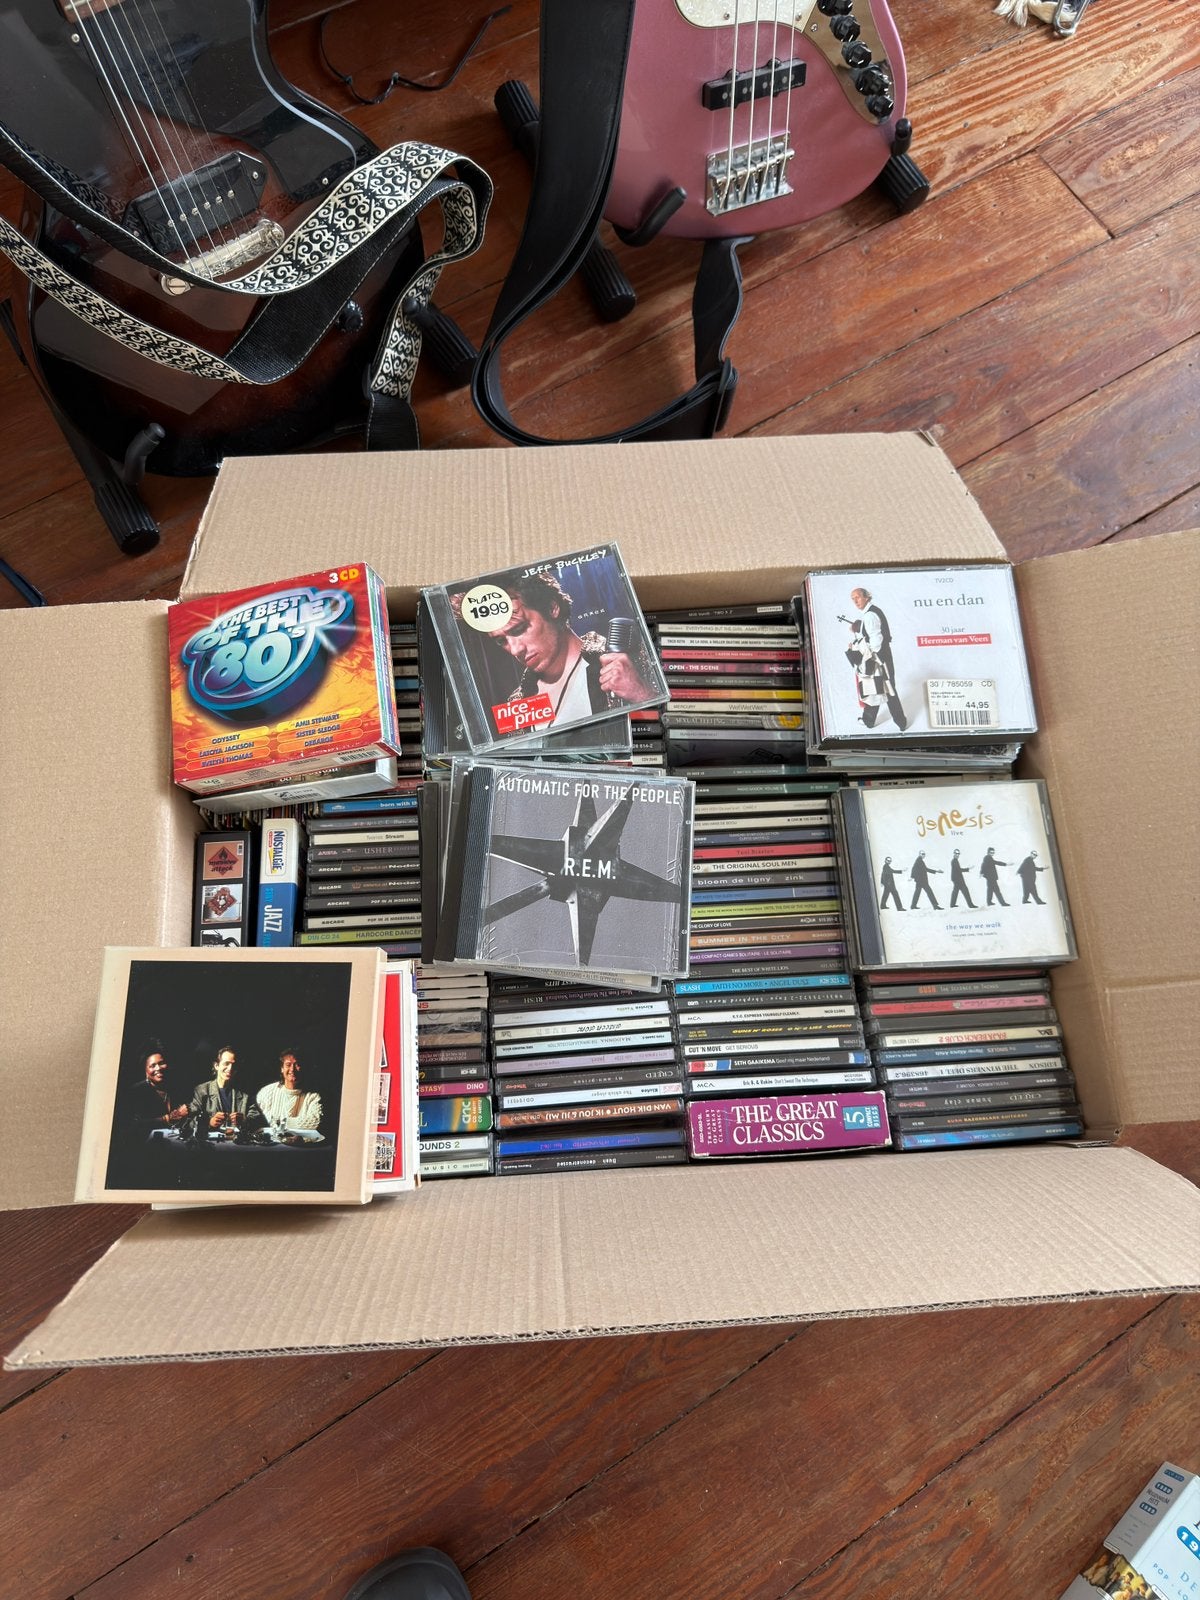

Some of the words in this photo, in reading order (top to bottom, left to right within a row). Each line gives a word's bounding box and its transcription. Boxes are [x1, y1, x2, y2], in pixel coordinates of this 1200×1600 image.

[521, 564, 552, 579] JEFF
[556, 549, 607, 569] BUCKLEY
[329, 573, 339, 583] 3
[339, 568, 359, 581] CD
[467, 592, 502, 604] PLATO
[914, 597, 933, 607] nu
[936, 597, 954, 606] en
[957, 594, 984, 606] dan
[220, 609, 251, 630] THE
[256, 596, 301, 619] BEST
[577, 609, 606, 619] GRACE
[200, 629, 238, 651] OF
[245, 598, 332, 638] THE
[941, 626, 950, 634] 30
[951, 626, 966, 635] jaar
[920, 636, 953, 645] Herman
[969, 635, 988, 643] Veen
[497, 702, 528, 719] nice
[965, 701, 989, 709] 44,95
[311, 713, 340, 725] STEWART
[515, 706, 552, 729] price
[212, 733, 240, 745] ODYSSEY
[295, 729, 316, 739] SISTER
[224, 741, 254, 753] JACKSON
[226, 752, 253, 763] THOMAS
[497, 779, 569, 796] AUTOMATIC
[574, 785, 599, 798] FOR
[604, 786, 627, 800] THE
[632, 788, 681, 805] PEOPLE
[916, 805, 993, 837] genesis
[564, 858, 616, 879] R.E.M.
[698, 878, 727, 886] bloem
[263, 905, 283, 933] JAZZ
[680, 984, 700, 992] SLASH
[944, 1035, 964, 1043] CLUB
[964, 1033, 991, 1041] BEACH
[991, 1032, 1007, 1040] BAJA
[1028, 1061, 1057, 1069] EDISON
[645, 1070, 673, 1079] CREED
[613, 1105, 636, 1114] HOUT
[637, 1104, 652, 1113] DIK
[653, 1103, 671, 1112] VAN
[731, 1105, 772, 1124] THE
[776, 1101, 839, 1121] GREAT
[578, 1109, 594, 1118] JOU
[847, 1112, 865, 1123] 5
[733, 1122, 825, 1145] CLASSICS
[419, 1141, 451, 1151] OUNDS
[1153, 1563, 1169, 1580] POP
